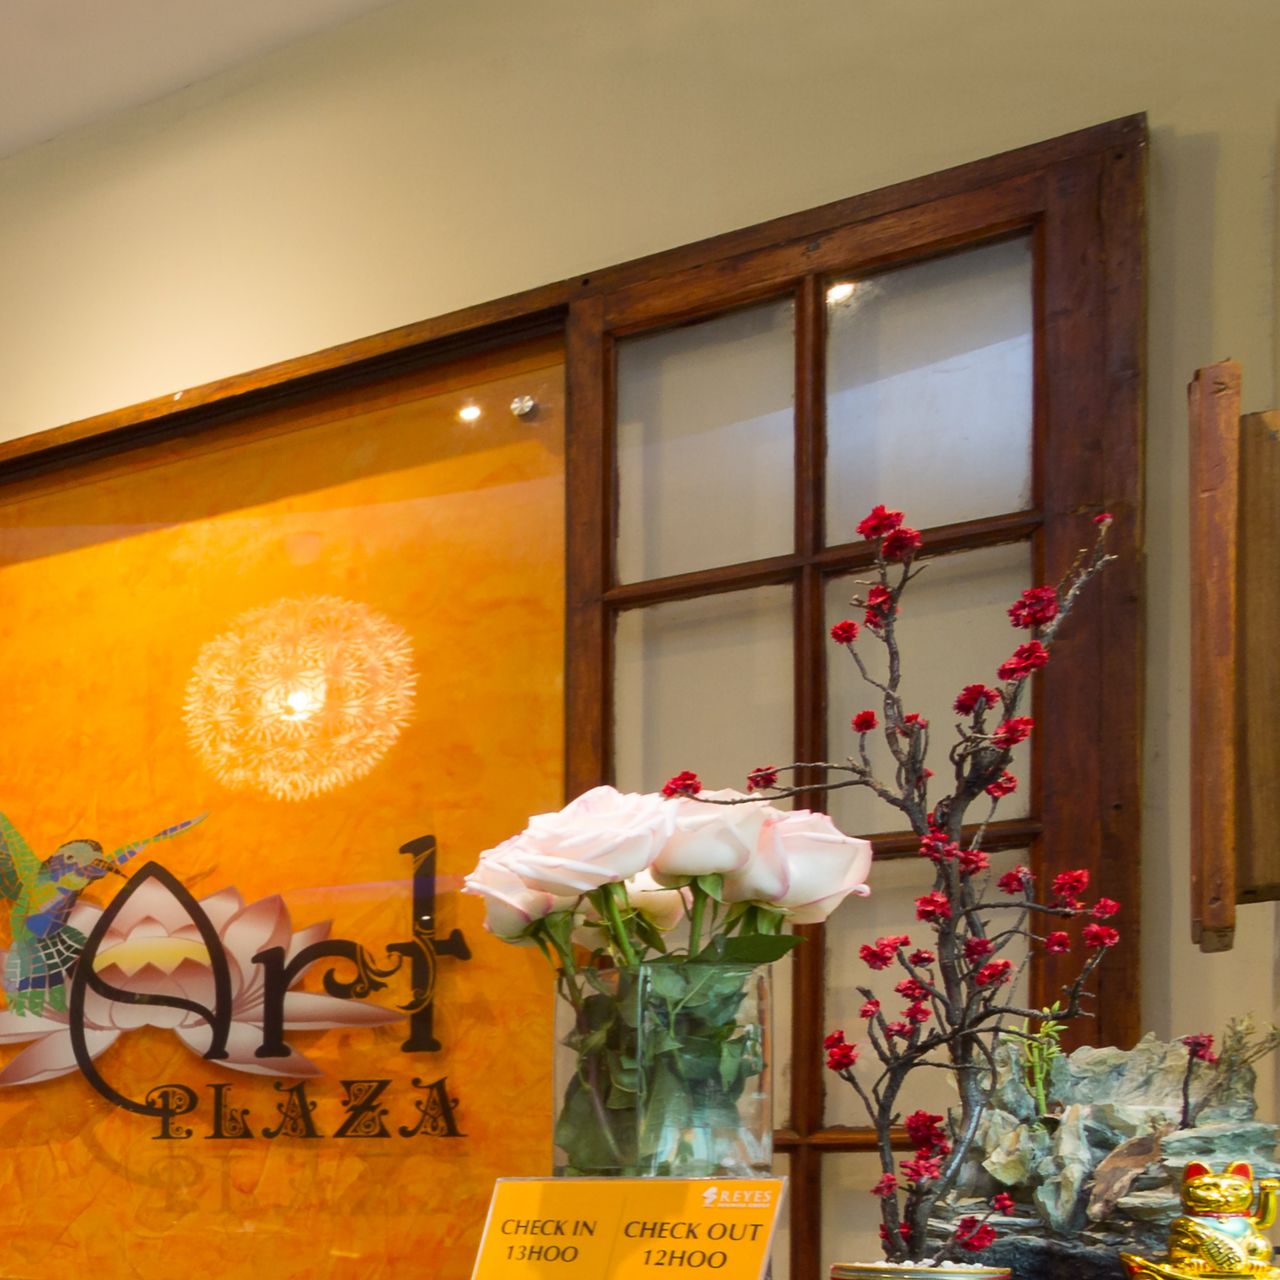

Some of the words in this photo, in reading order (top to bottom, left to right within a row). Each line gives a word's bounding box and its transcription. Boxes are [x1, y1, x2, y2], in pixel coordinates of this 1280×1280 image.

[69, 835, 472, 1116] Art
[146, 1076, 468, 1140] PLAZA
[720, 1190, 773, 1203] REYES
[500, 1219, 569, 1237] CHECK
[572, 1219, 597, 1237] IN
[624, 1220, 700, 1241] CHECK
[707, 1222, 764, 1242] OUT
